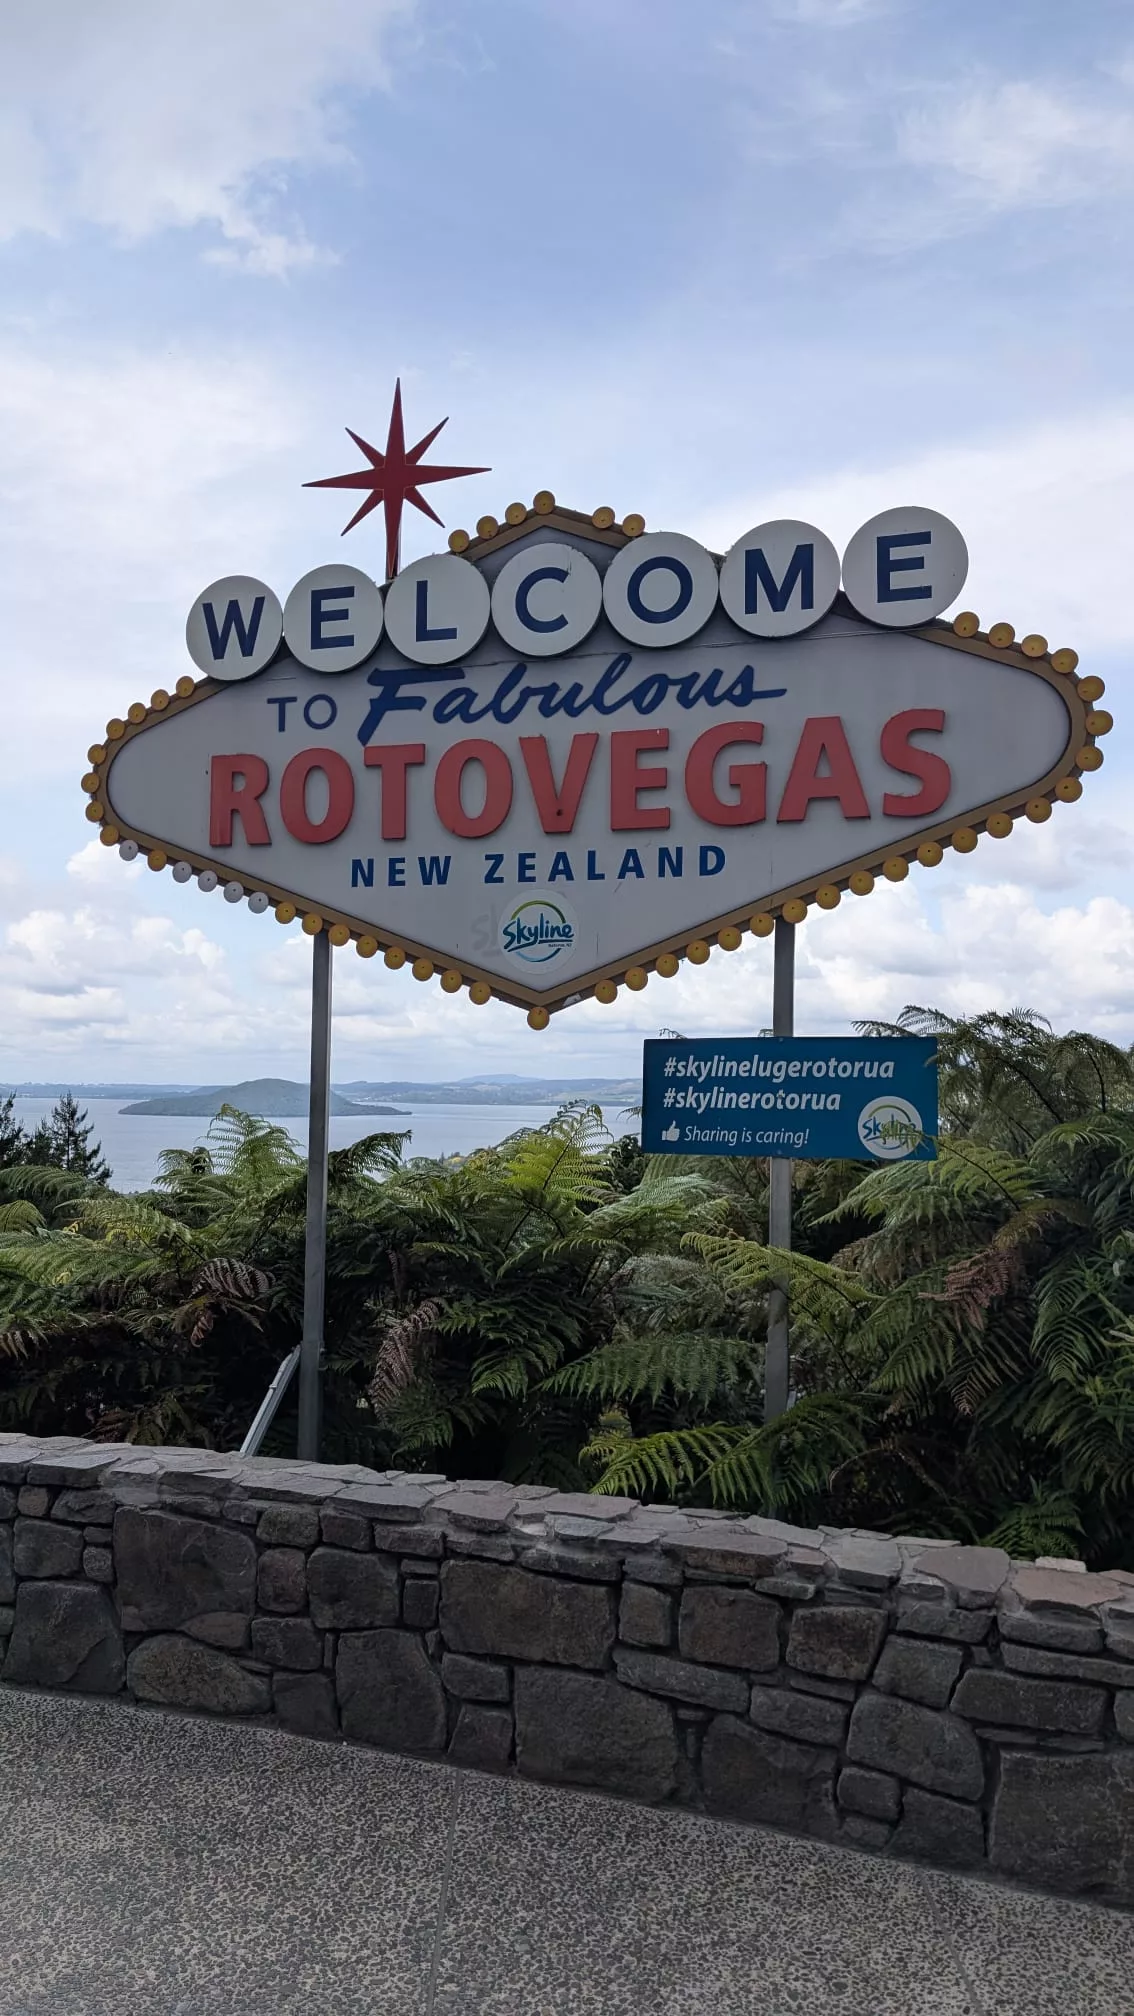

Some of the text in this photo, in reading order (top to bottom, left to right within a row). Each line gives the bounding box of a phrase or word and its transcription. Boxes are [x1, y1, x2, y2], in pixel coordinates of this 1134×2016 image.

[203, 530, 933, 660] WELCOME
[266, 653, 787, 746] TO Fabulous
[209, 708, 953, 847] ROTOVEGAS
[350, 844, 727, 888] NEW ZEALAND
[503, 912, 574, 953] Skyline
[663, 1054, 895, 1083] #skylinelugerotorua
[662, 1085, 842, 1114] #skylinerotorua
[683, 1125, 810, 1148] Sharing is caring!
